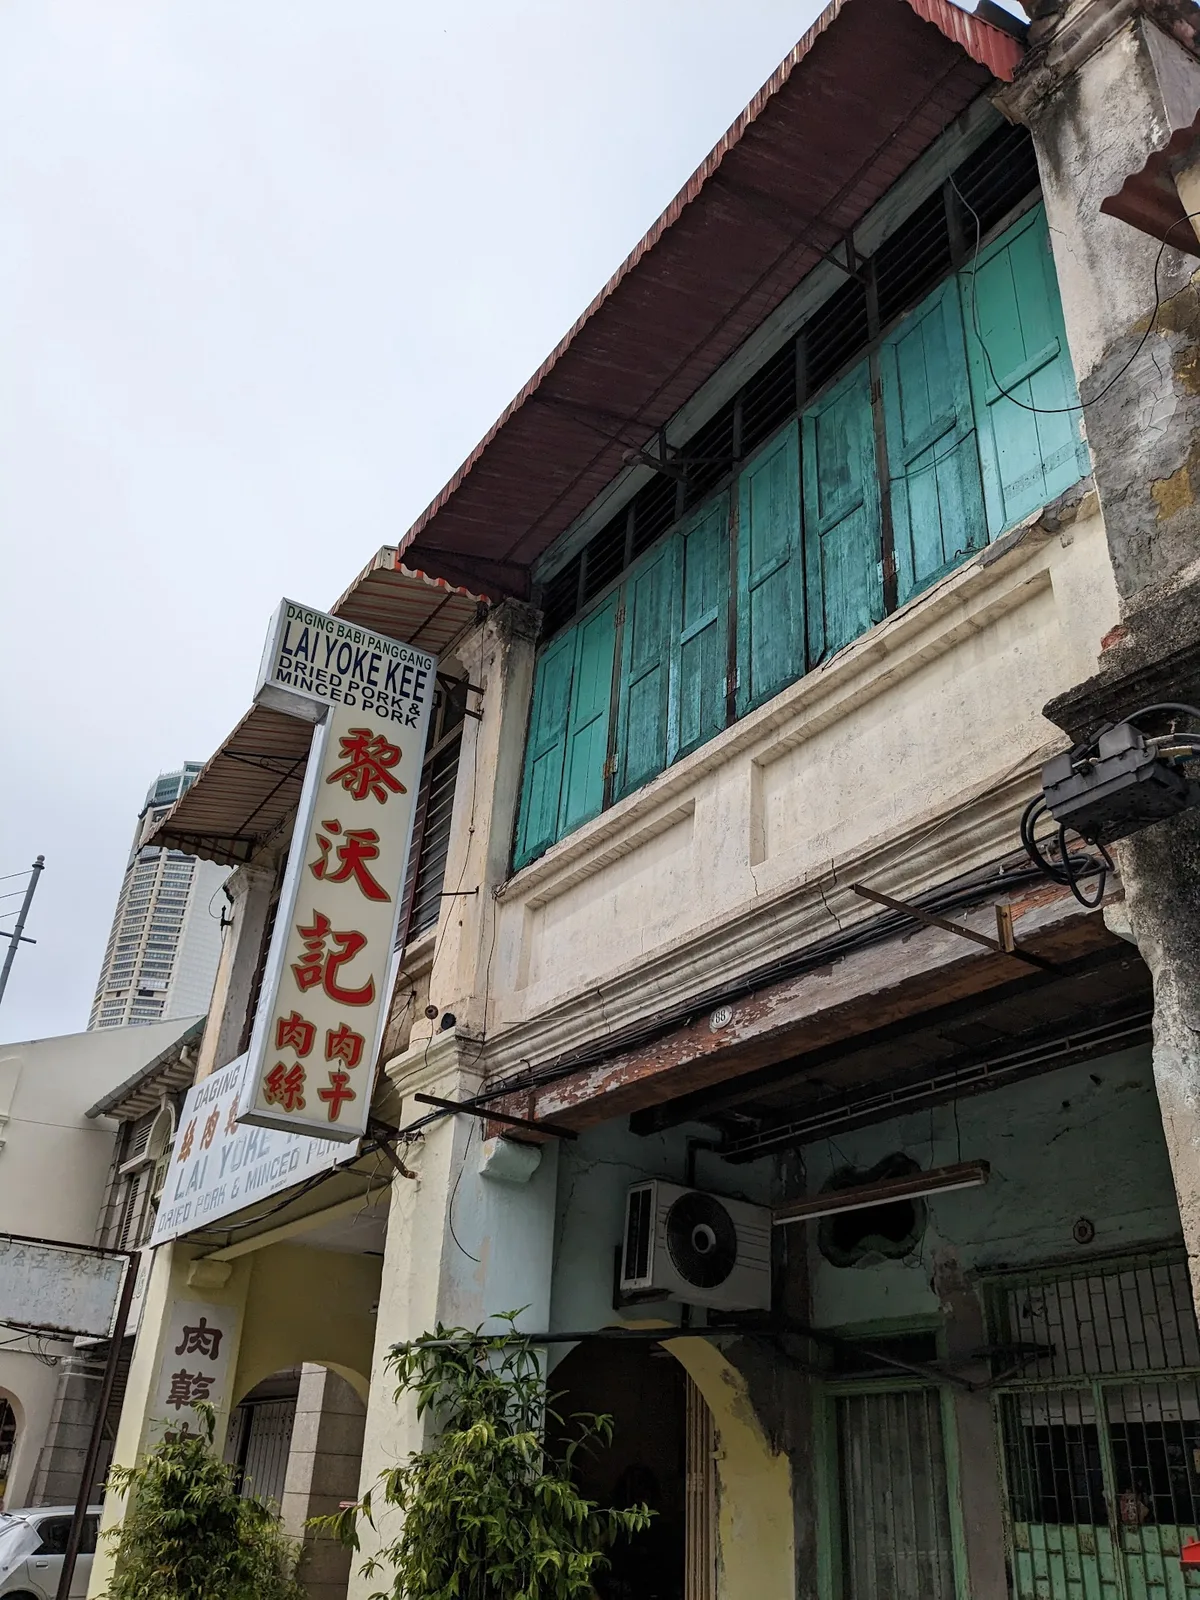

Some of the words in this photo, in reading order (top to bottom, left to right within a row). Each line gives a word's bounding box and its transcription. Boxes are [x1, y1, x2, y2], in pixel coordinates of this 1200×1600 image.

[281, 621, 319, 663] LAI
[325, 635, 382, 687] YOKE
[384, 659, 428, 703] KEE
[286, 606, 334, 633] DAGING
[337, 627, 365, 646] BABI
[367, 637, 432, 671] PANGGANG
[276, 669, 356, 706] MINCED
[361, 700, 417, 729] PORK
[278, 656, 342, 687] DRIED
[349, 681, 403, 710] PORK
[408, 703, 421, 717] &
[193, 1065, 241, 1112] DAGING
[158, 1201, 192, 1232] DRIED
[195, 1184, 227, 1217] PORK
[231, 1176, 240, 1199] &
[245, 1147, 300, 1193] MINCED
[174, 1155, 208, 1201] LAI
